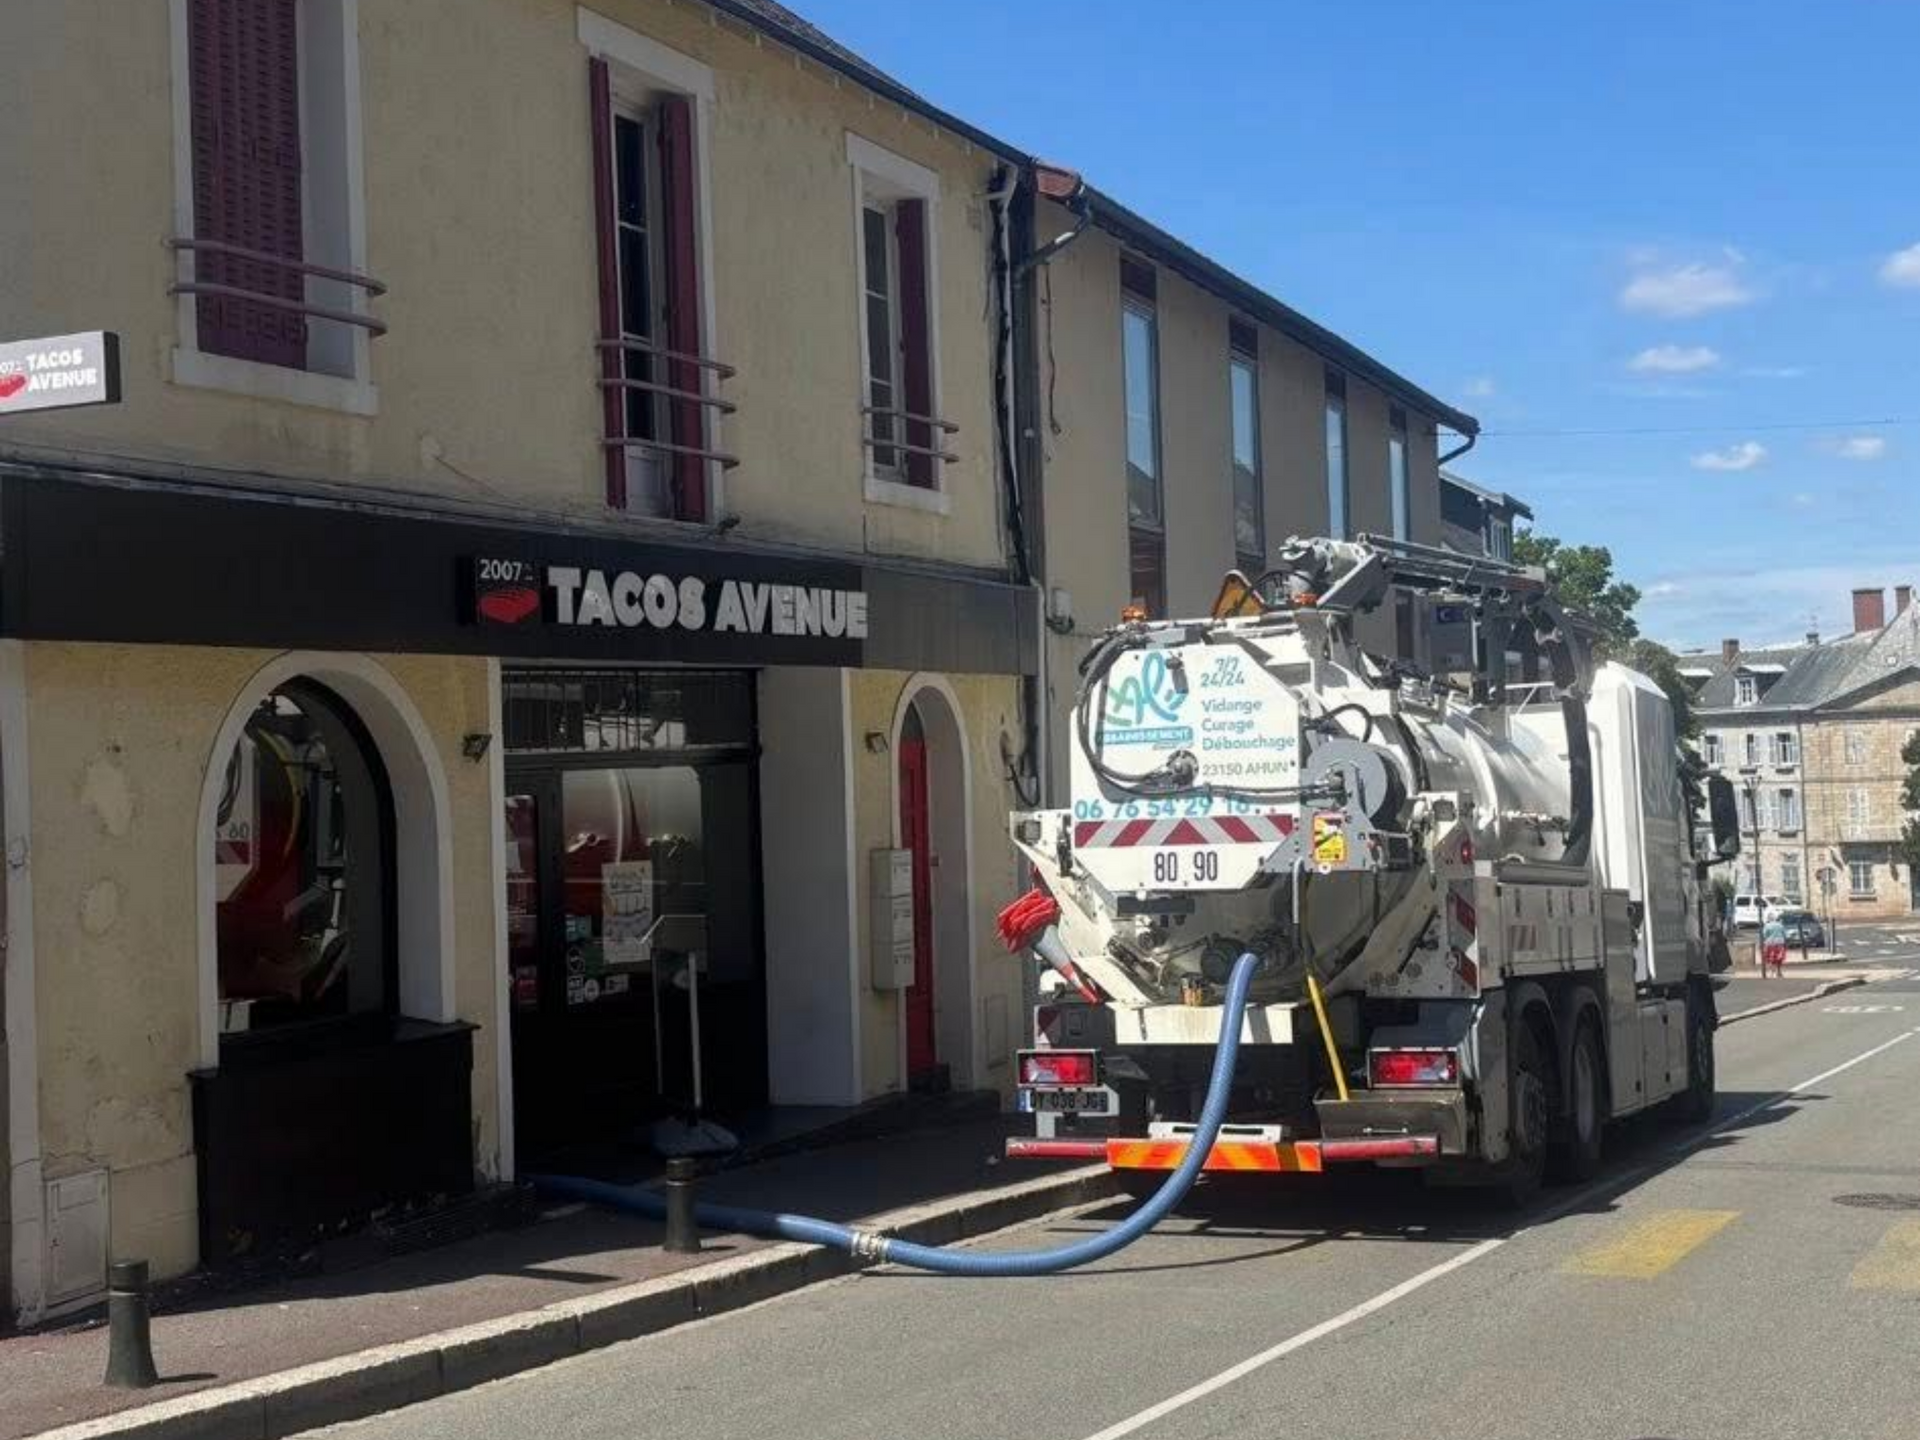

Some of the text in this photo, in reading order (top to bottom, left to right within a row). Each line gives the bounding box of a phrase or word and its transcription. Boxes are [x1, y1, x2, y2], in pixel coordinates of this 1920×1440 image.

[26, 348, 82, 371] TACOS
[28, 368, 97, 392] AVENUE
[480, 559, 522, 581] 2007
[548, 566, 869, 639] TACOS AVENUE
[1201, 670, 1245, 687] 24/24
[1202, 698, 1262, 714] Vidange
[1202, 718, 1254, 734] Curage
[1202, 733, 1296, 751] Débouchage
[1203, 761, 1288, 777] 23150 AHUN
[1075, 800, 1103, 819] 06
[1147, 799, 1176, 816] 54
[1184, 796, 1213, 816] 29
[1154, 851, 1218, 882] 80 90
